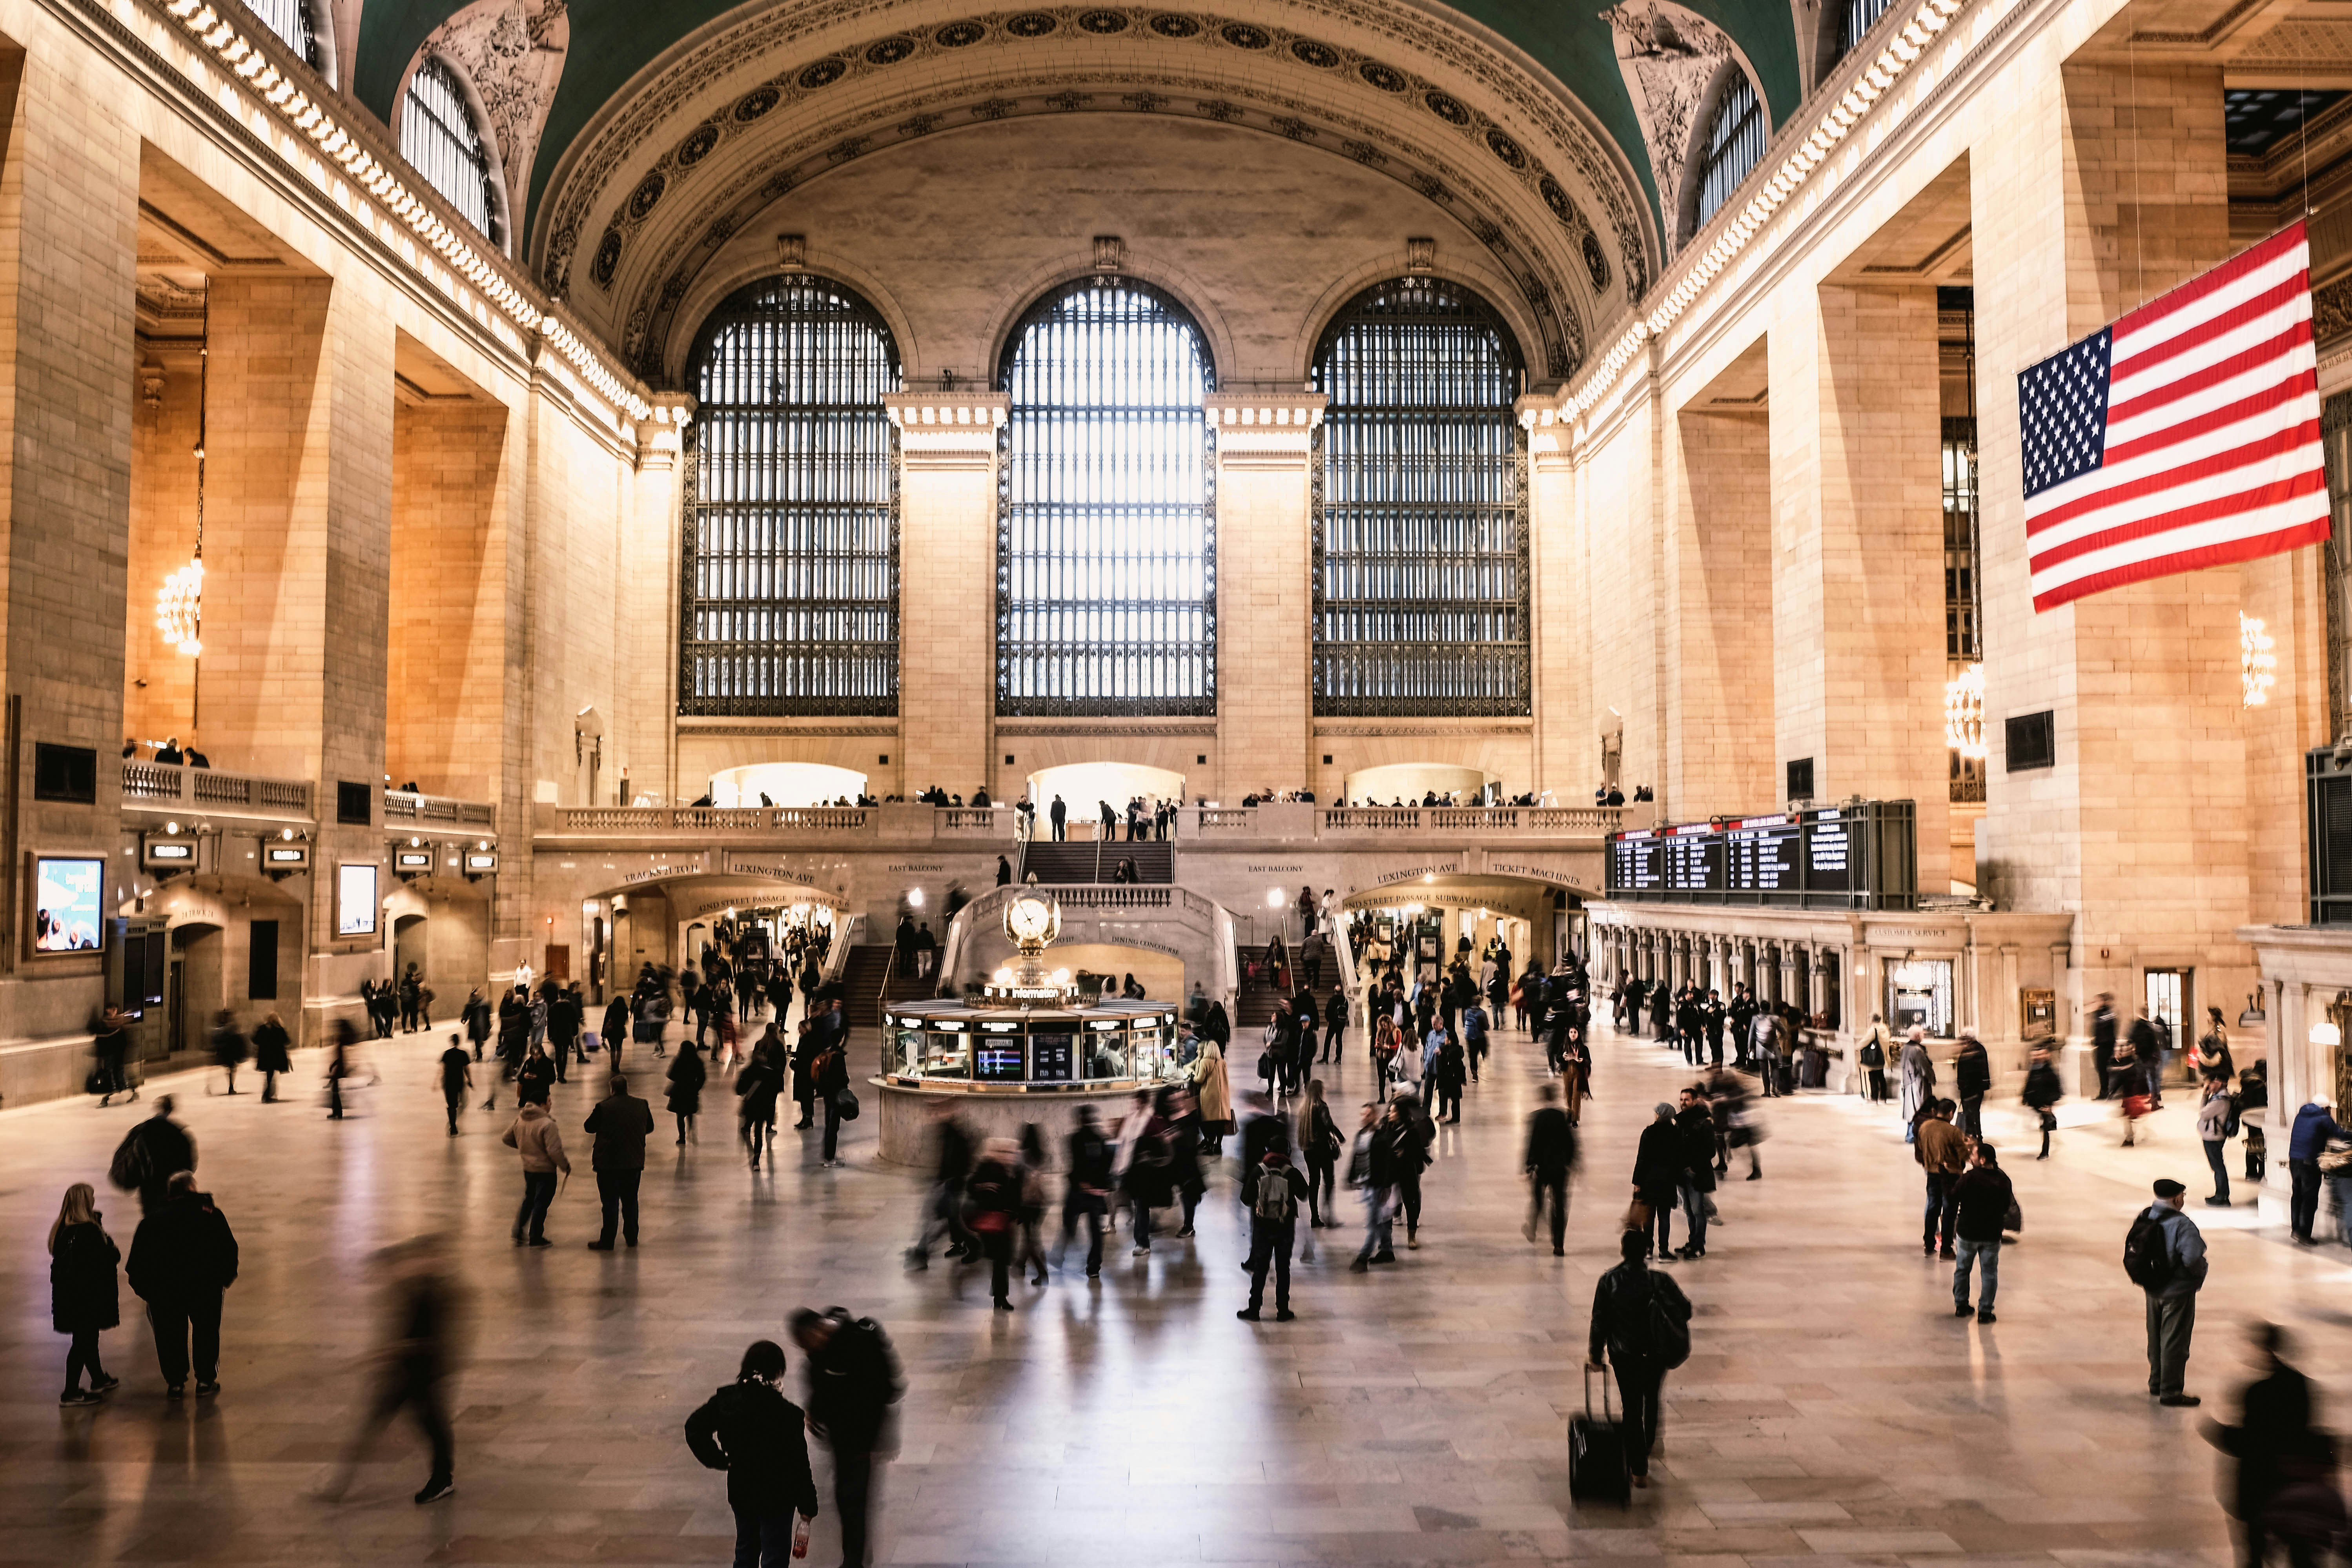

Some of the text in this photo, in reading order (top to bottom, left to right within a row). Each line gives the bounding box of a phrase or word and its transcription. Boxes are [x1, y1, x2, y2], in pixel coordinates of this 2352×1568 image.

[623, 868, 661, 882] TRACKS
[675, 865, 688, 874] TO
[734, 863, 815, 884] LEXINGTON AVE
[1377, 863, 1457, 883] LEXINGTON AVE
[1493, 864, 1580, 885] TICKET MACHINES
[698, 895, 787, 912] 42ND STREET PASSAGE
[795, 895, 828, 903] SUBWAY
[1344, 901, 1362, 911] 2ND
[1363, 896, 1393, 907] STREET
[1436, 895, 1470, 903] SUBWAY
[1111, 936, 1179, 955] DINING CONCOURSE
[1012, 987, 1058, 998] Information
